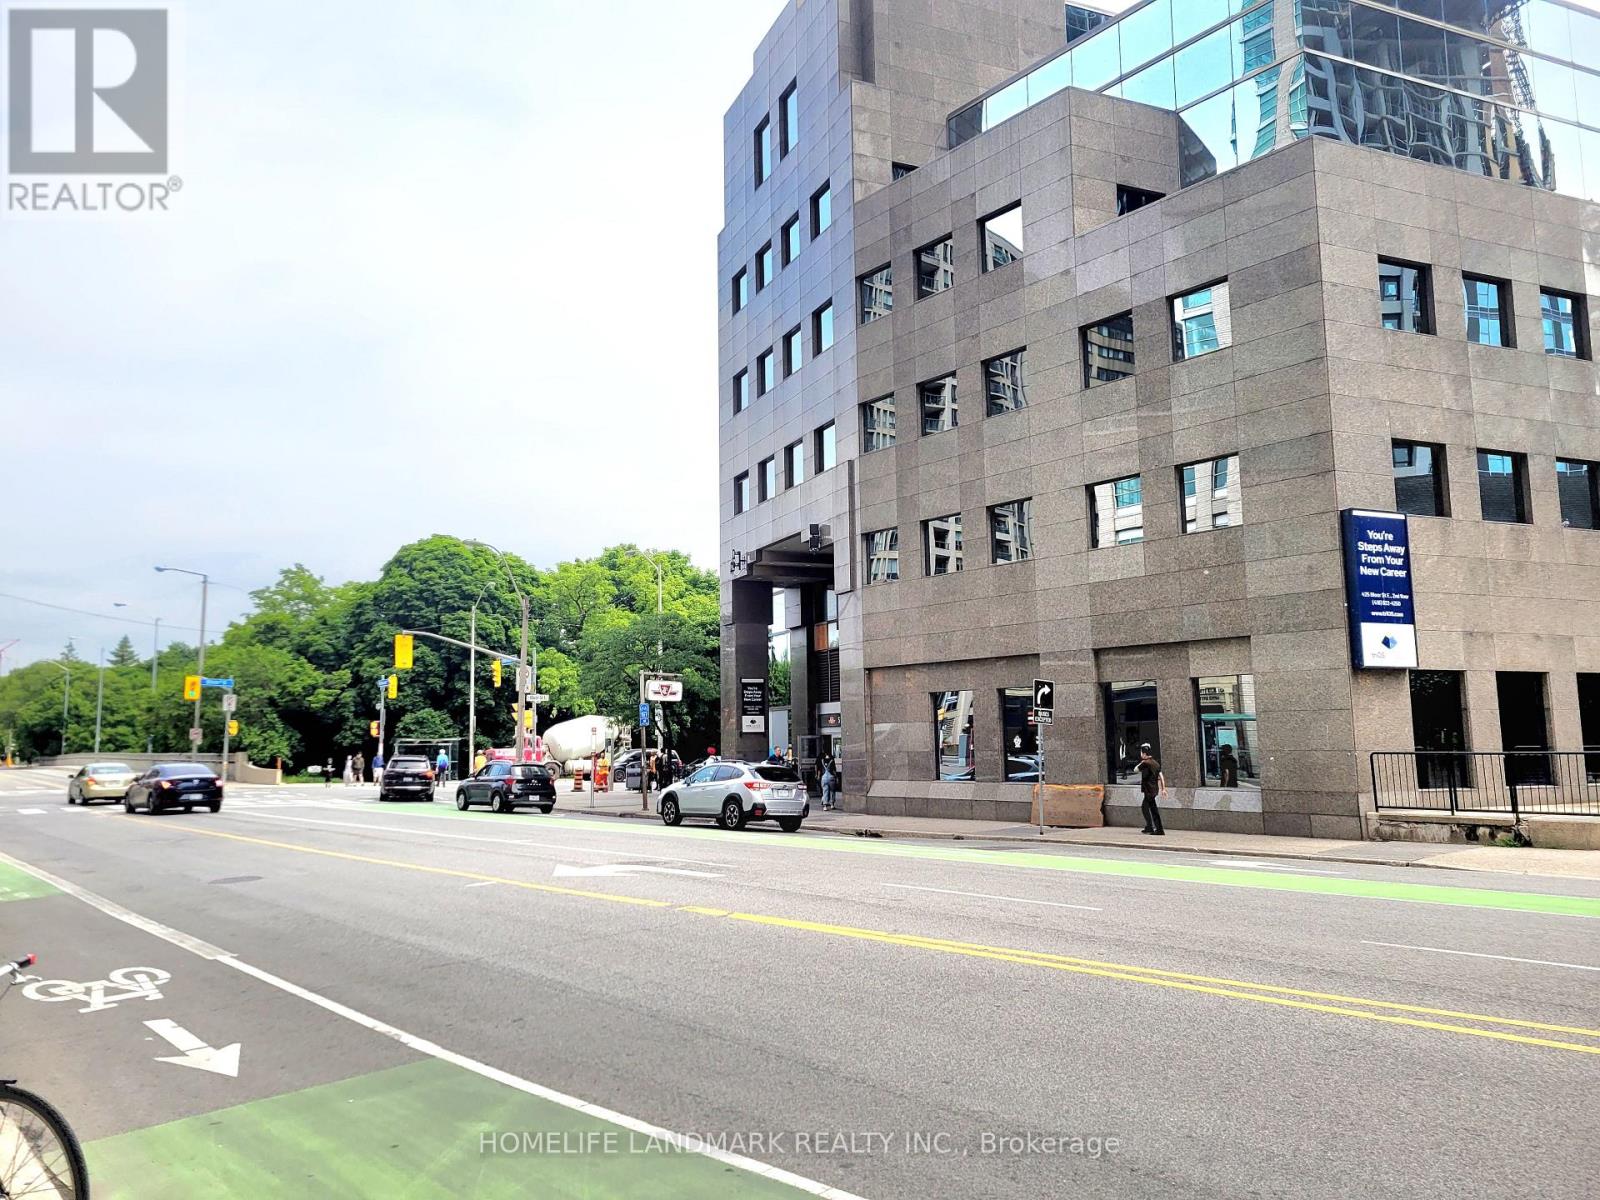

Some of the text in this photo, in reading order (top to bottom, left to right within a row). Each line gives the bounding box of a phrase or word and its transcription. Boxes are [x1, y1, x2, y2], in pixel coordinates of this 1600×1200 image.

[1367, 530, 1394, 541] You're
[1358, 541, 1406, 556] Steps Away
[1361, 553, 1404, 566] From Your
[1360, 565, 1407, 578] New Career
